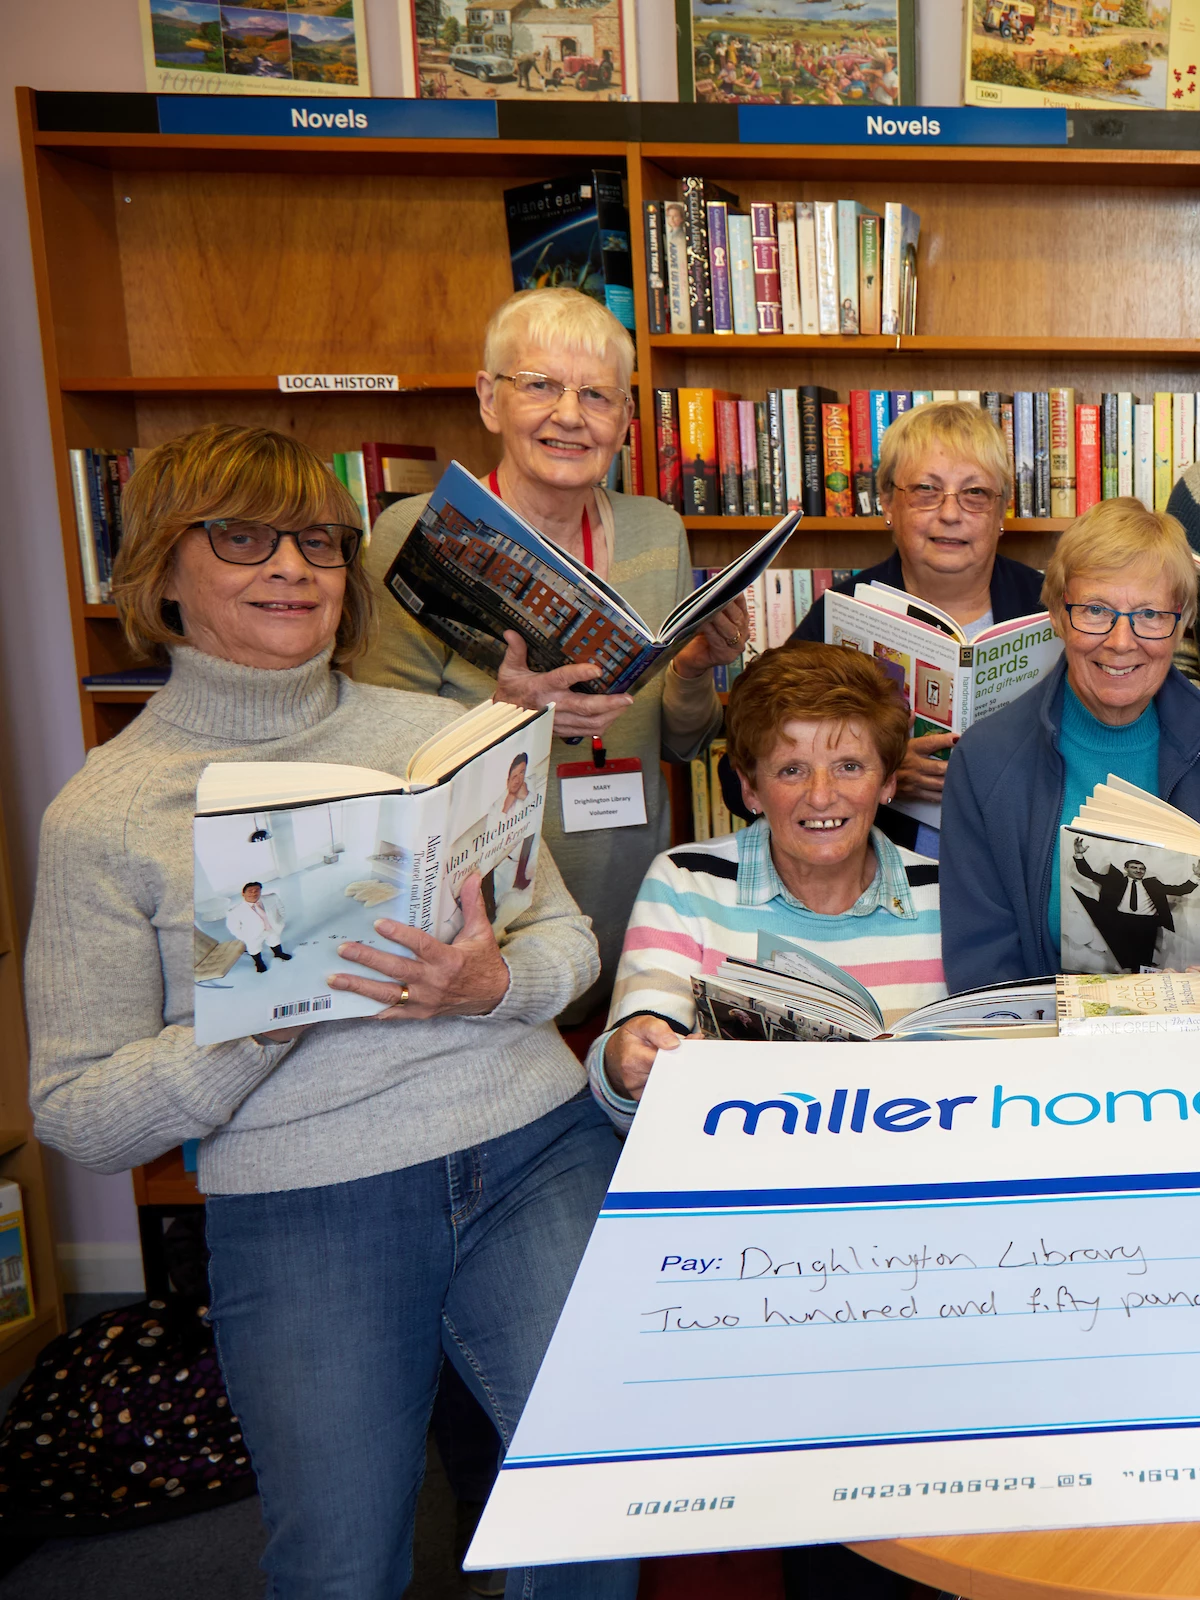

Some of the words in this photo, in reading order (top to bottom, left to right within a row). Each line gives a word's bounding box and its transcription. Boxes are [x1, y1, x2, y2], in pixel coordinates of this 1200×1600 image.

[980, 90, 998, 99] 1000
[291, 108, 369, 129] Novels
[866, 116, 941, 136] Novels
[509, 196, 550, 217] planet
[649, 214, 657, 228] THE
[758, 208, 769, 236] Cecelia
[650, 229, 658, 251] WHITE
[651, 252, 659, 273] TIGER
[670, 243, 679, 269] ABOVE
[286, 375, 332, 390] LOCAL
[335, 375, 395, 391] HISTORY
[803, 396, 816, 451] ARCHER
[827, 405, 845, 466] ARCHER
[1051, 400, 1067, 449] ARCHER
[748, 605, 757, 643] ATKINSON
[976, 627, 1060, 666] handma
[975, 653, 1029, 685] cards
[975, 682, 994, 699] and
[996, 668, 1039, 693] gift-wrap
[962, 676, 970, 715] handmade
[975, 702, 988, 711] over
[574, 797, 610, 806] Drighlington
[444, 851, 469, 877] Alan
[472, 792, 543, 853] Titchmarsh
[485, 841, 504, 859] and
[504, 821, 531, 846] Error
[426, 834, 441, 865] Alan
[414, 850, 424, 881] Trowel
[411, 883, 420, 898] and
[419, 864, 440, 934] Titchmarsh
[1133, 977, 1157, 1010] GREEN
[1176, 980, 1196, 1006] Husband
[1091, 1022, 1122, 1035] JANE
[1124, 1021, 1168, 1034] GREEN
[1172, 1016, 1187, 1025] The
[703, 1088, 978, 1136] miller
[661, 1255, 723, 1275] Pay:
[738, 1245, 977, 1292] Drighlington
[998, 1238, 1148, 1276] Library
[640, 1306, 740, 1333] Two
[764, 1295, 918, 1326] hundred
[940, 1290, 998, 1319] and
[1029, 1285, 1100, 1332] fifty
